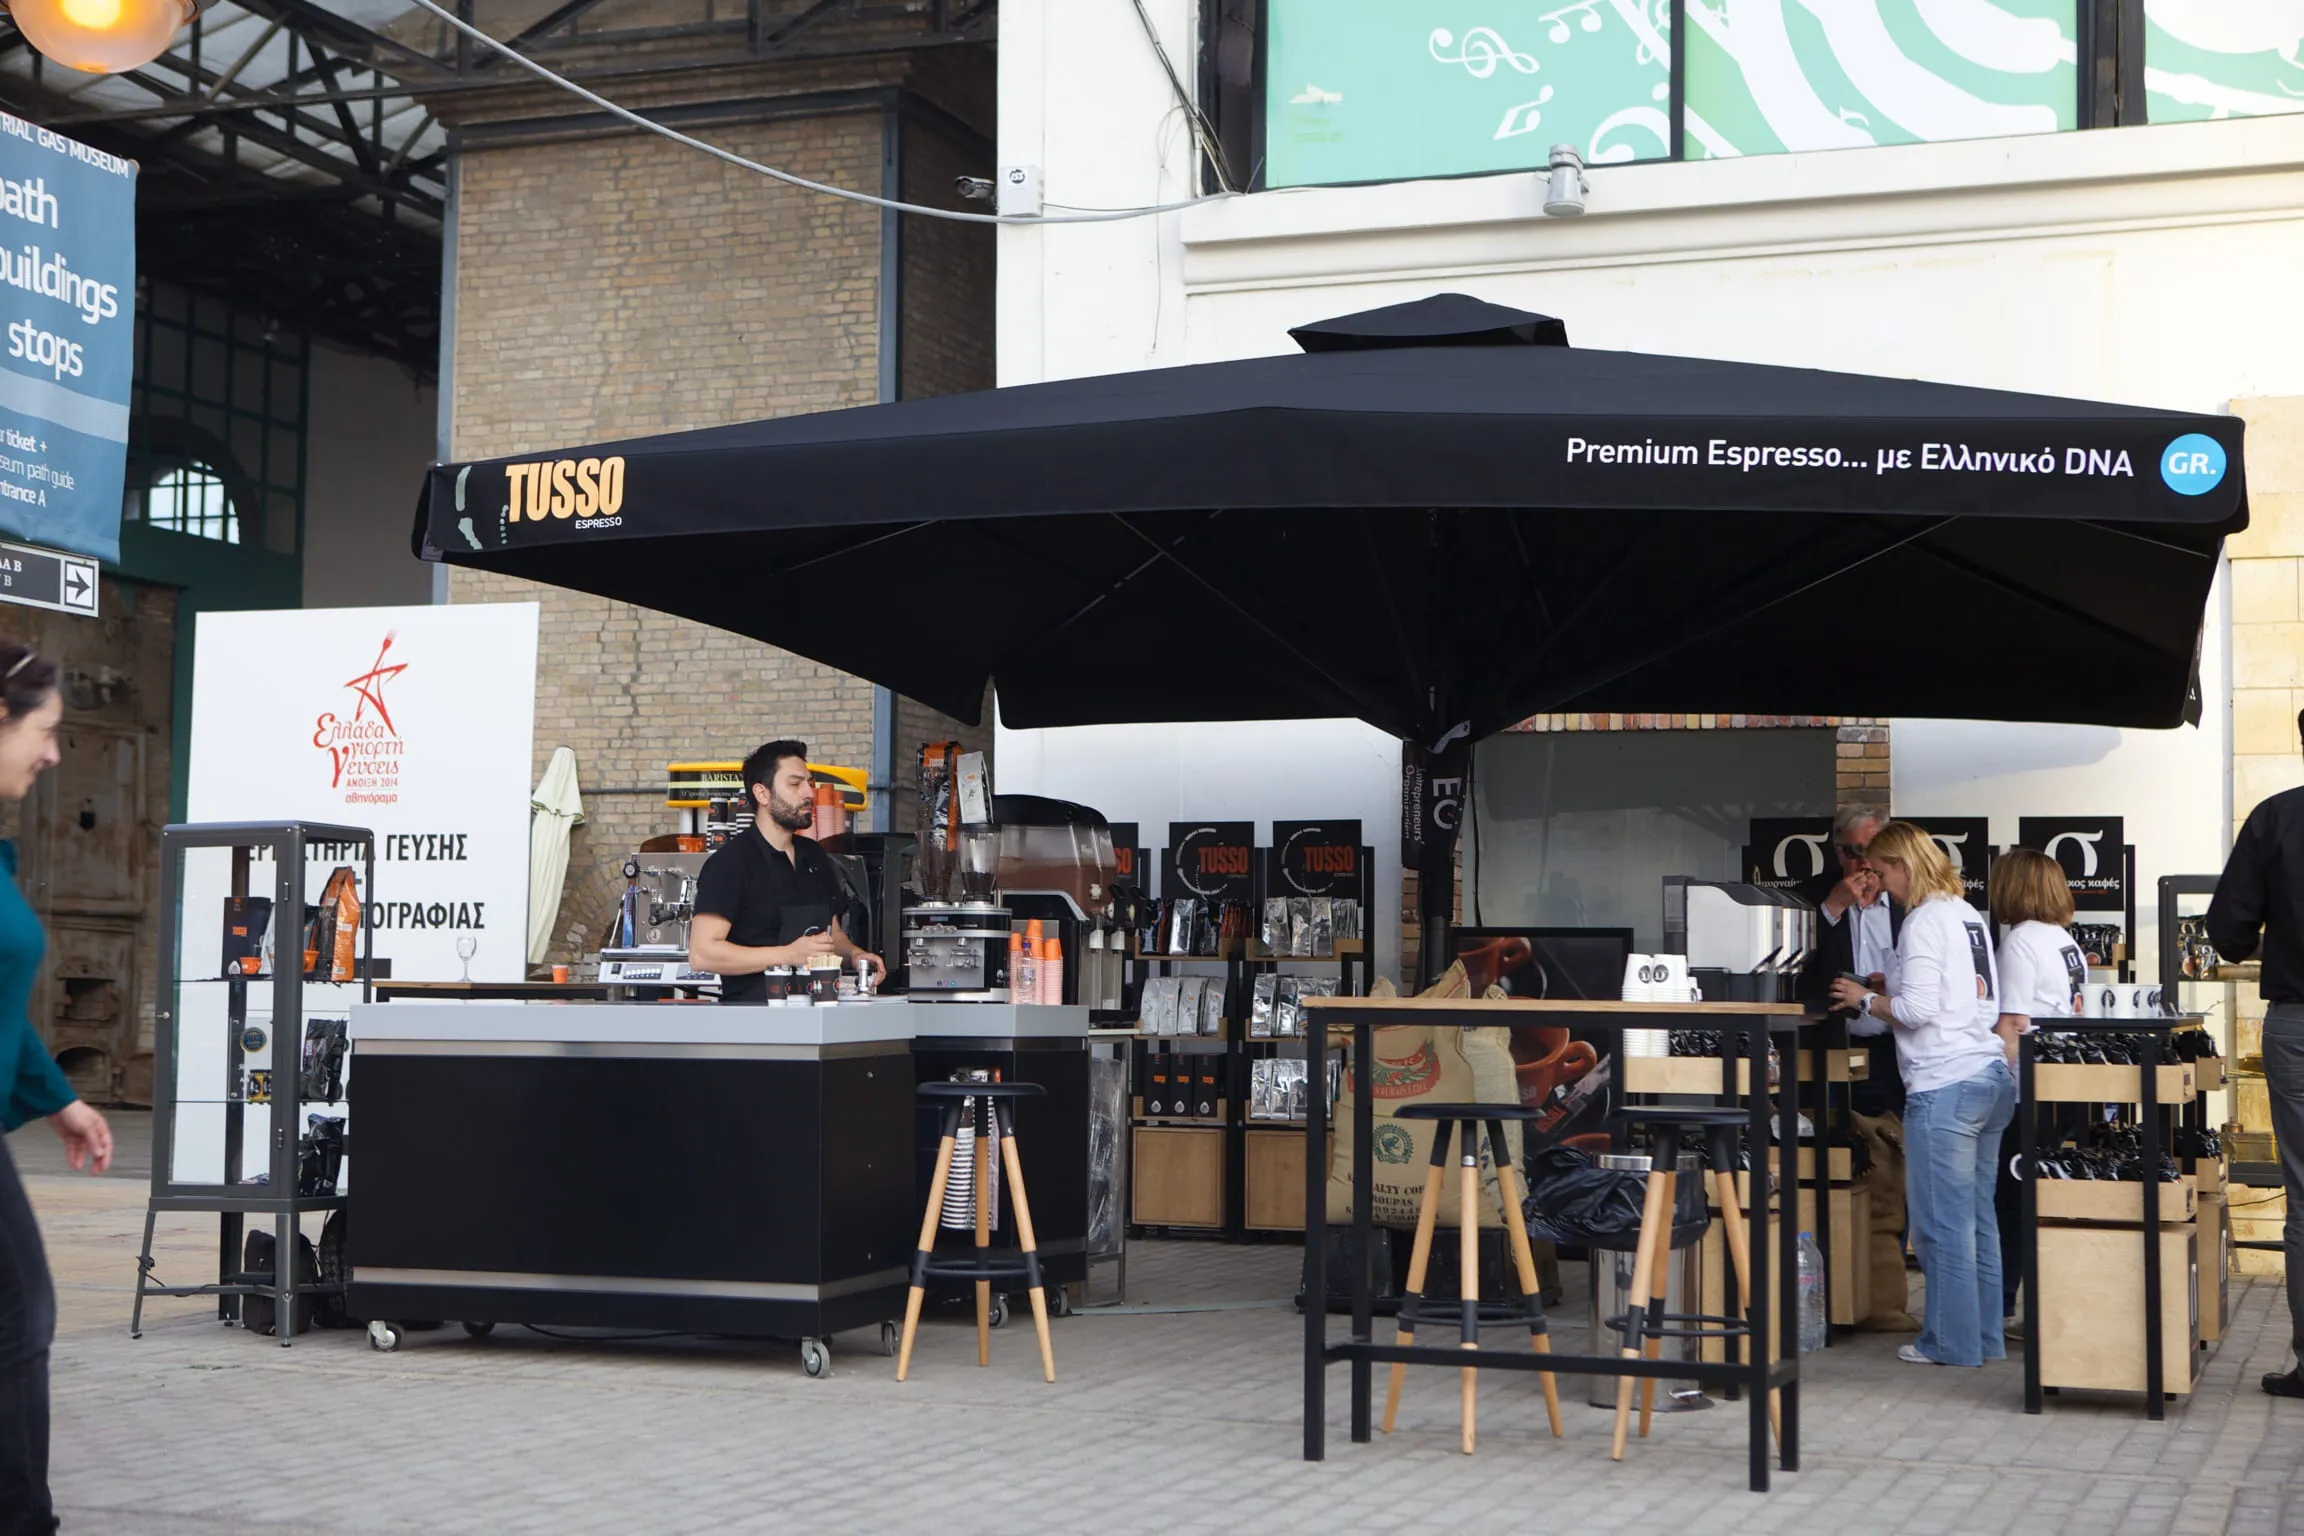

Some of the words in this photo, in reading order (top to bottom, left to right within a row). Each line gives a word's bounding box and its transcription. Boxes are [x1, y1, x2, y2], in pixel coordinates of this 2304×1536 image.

[37, 127, 66, 154] GAS
[69, 140, 129, 179] MUSEUM
[8, 319, 83, 380] stops
[6, 428, 37, 453] ticket
[1566, 437, 1699, 465] Premium
[1707, 439, 1868, 472] Espresso...
[1876, 448, 1912, 475] με
[1920, 443, 2056, 474] Ελληνικό
[2063, 447, 2135, 477] DNA
[2167, 451, 2217, 476] GR.
[27, 463, 50, 482] path
[37, 489, 47, 508] A
[505, 456, 625, 523] TUSSO
[575, 516, 623, 530] ESPRESSO
[313, 712, 384, 748] Ελλάδα
[351, 735, 404, 759] γιορτή
[380, 777, 399, 788] 2014
[386, 834, 468, 861] ΓΕΥΣΗΣ
[1198, 846, 1249, 874] TUSSO
[1303, 845, 1354, 874] TUSSO
